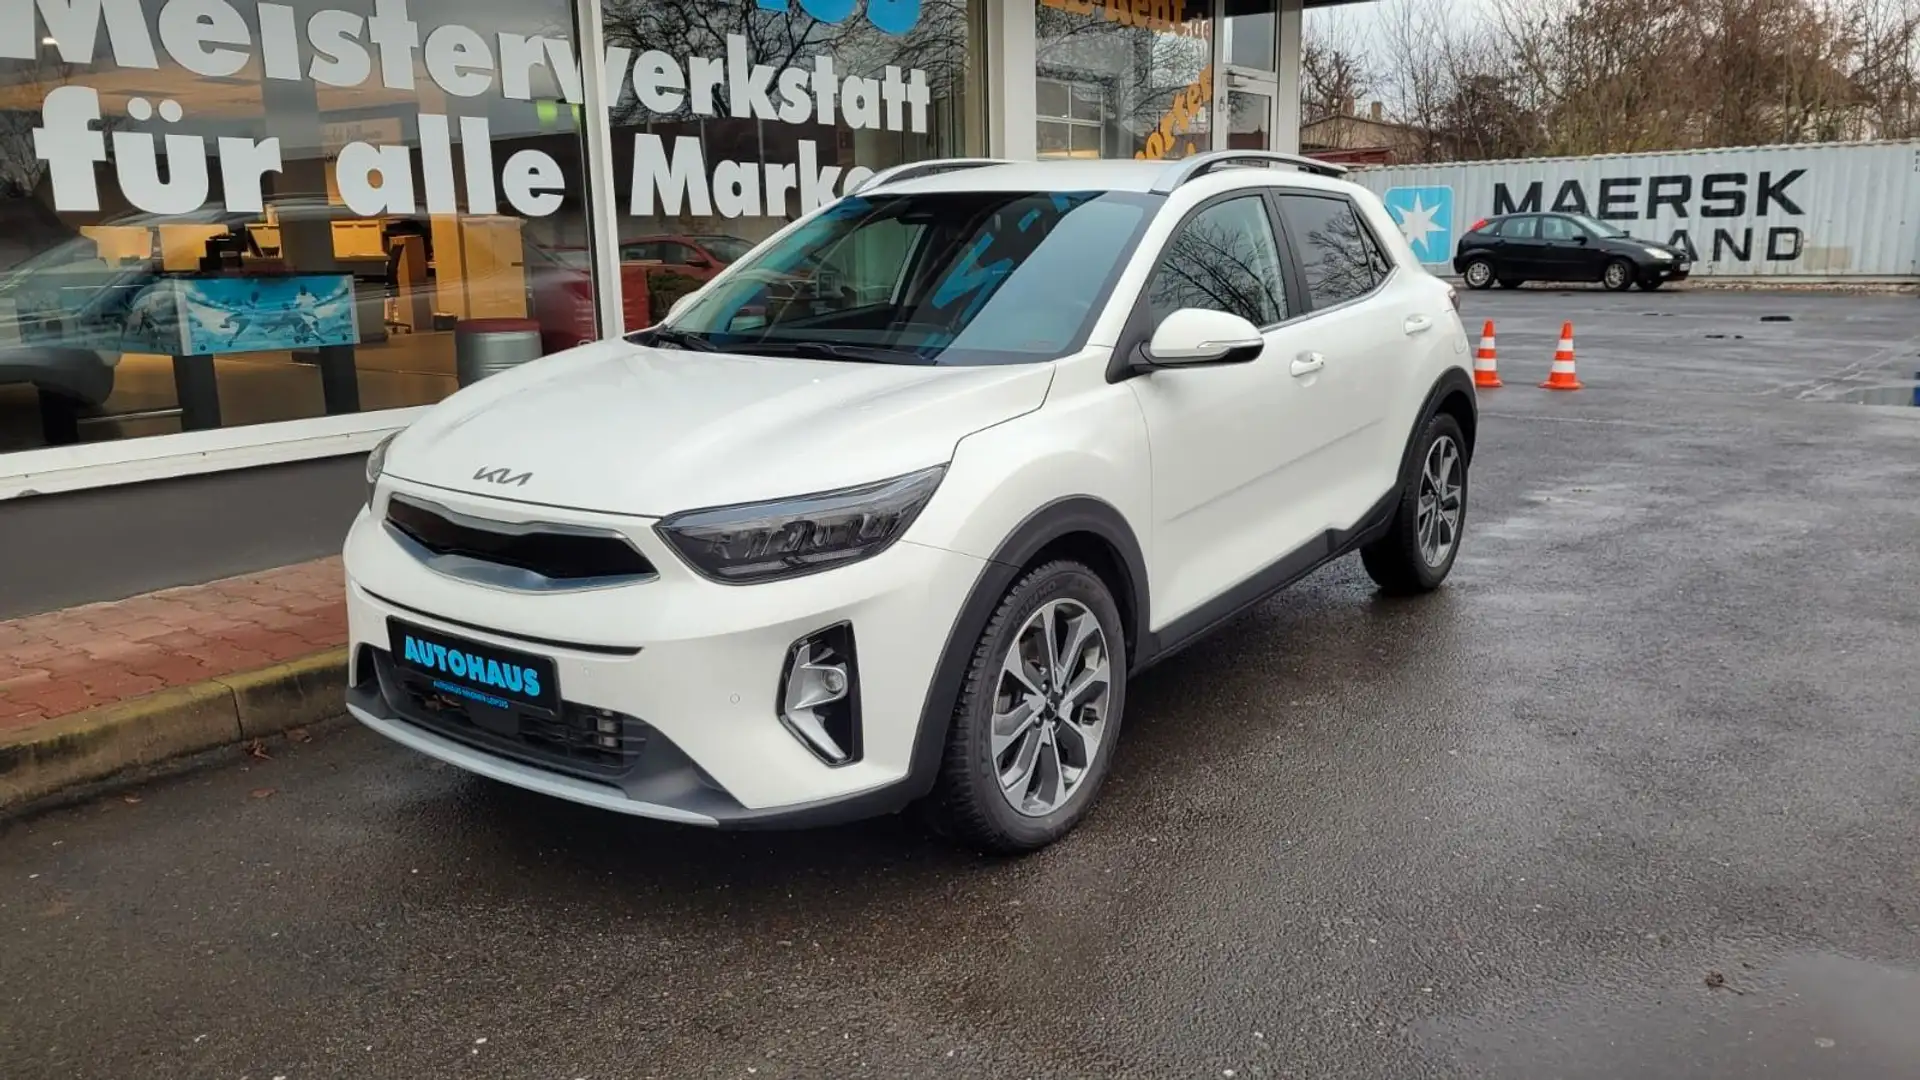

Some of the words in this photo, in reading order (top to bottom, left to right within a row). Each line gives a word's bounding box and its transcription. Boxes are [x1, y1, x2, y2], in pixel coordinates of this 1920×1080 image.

[33, 86, 283, 214] für
[336, 113, 566, 217] alle
[1493, 168, 1808, 220] MAERSK
[472, 466, 534, 488] KIA
[404, 634, 541, 697] AUTOHAUS
